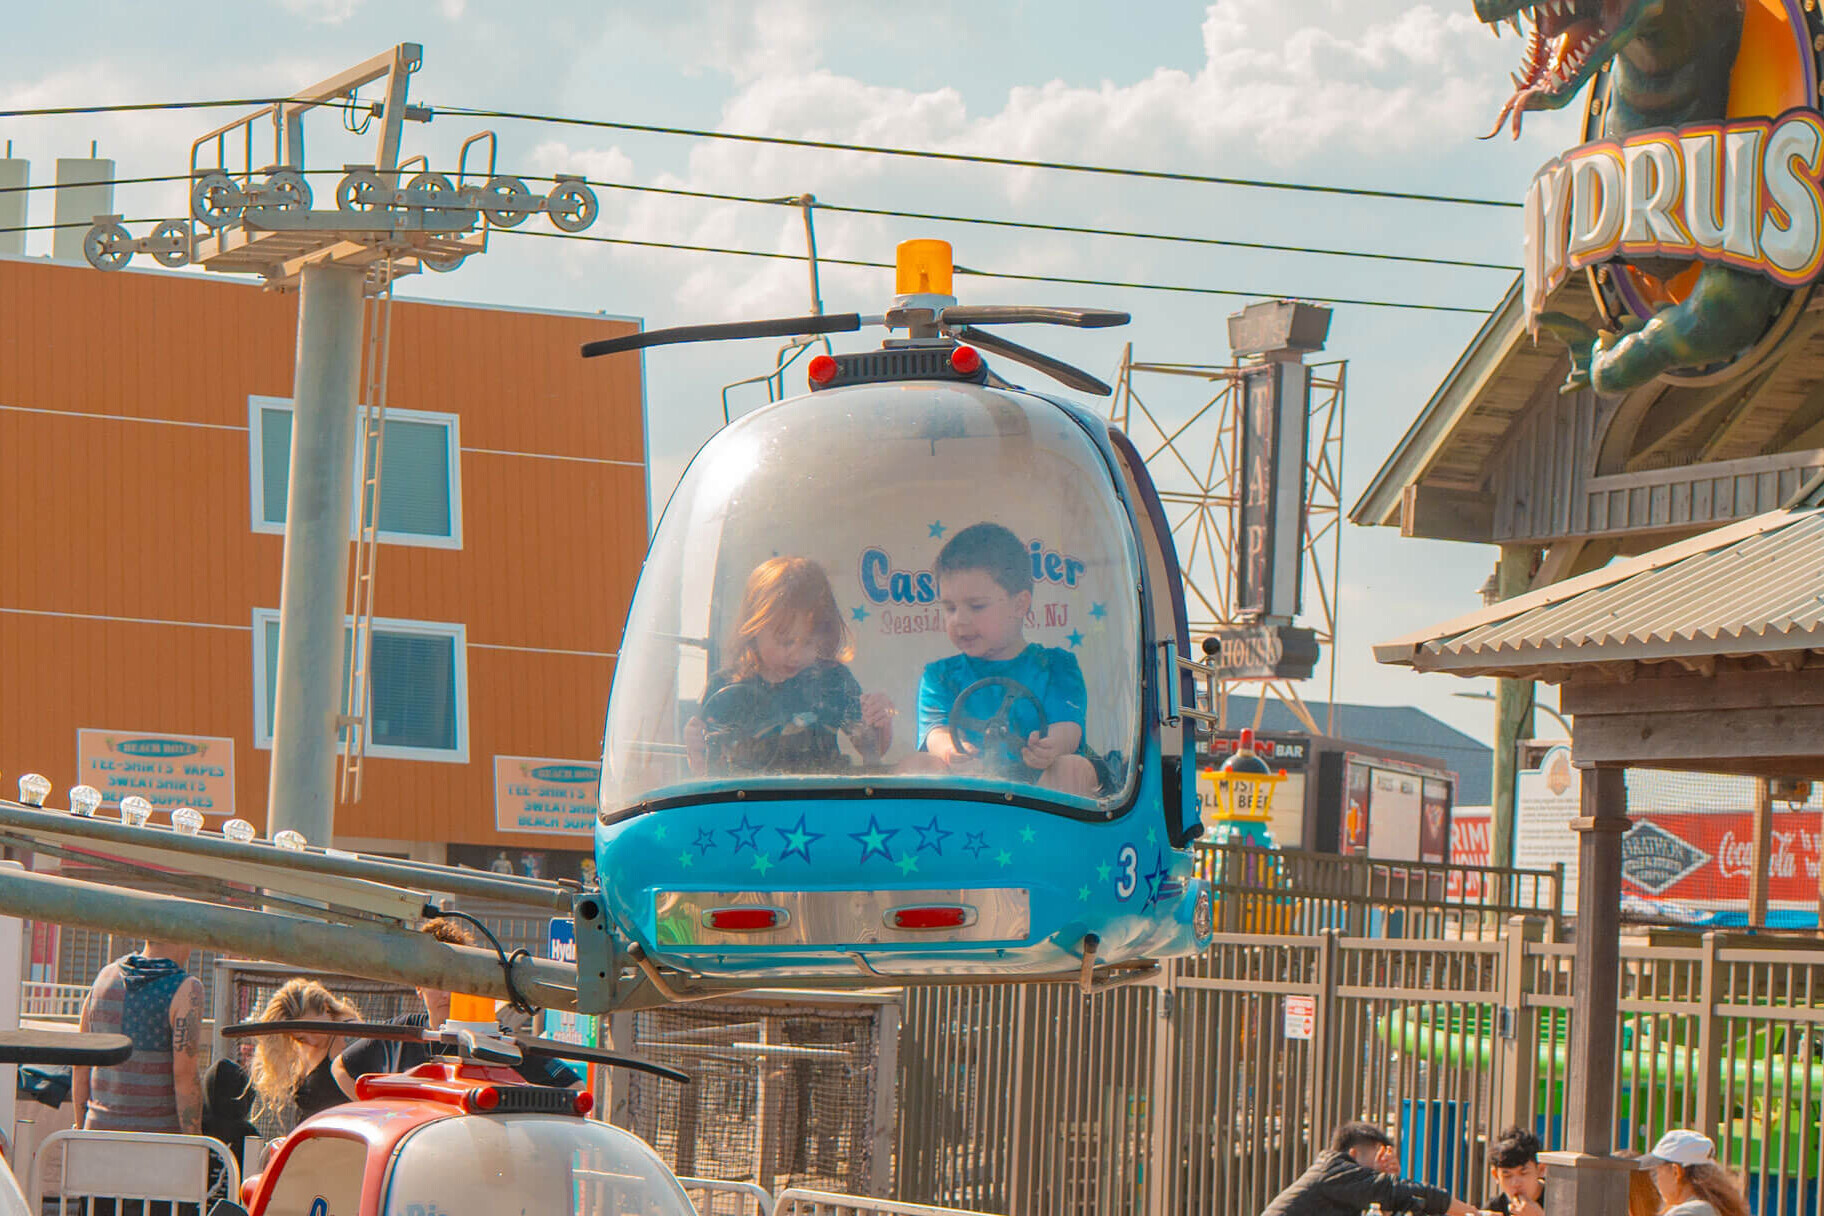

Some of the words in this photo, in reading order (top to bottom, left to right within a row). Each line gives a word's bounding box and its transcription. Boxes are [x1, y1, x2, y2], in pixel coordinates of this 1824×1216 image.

[1524, 113, 1820, 322] YDRUS
[1246, 387, 1268, 592] TAP
[860, 547, 940, 605] Cas
[1029, 541, 1085, 588] ier
[1045, 604, 1069, 627] NJ
[1276, 744, 1304, 758] BAR
[182, 764, 225, 777] VAPES
[108, 775, 207, 792] SWEATSHIRTS
[1219, 780, 1263, 793] MUSI
[150, 793, 214, 808] SUPPLIES
[518, 816, 559, 828] BEACH
[563, 818, 597, 830] SUPP
[1116, 846, 1138, 900] 3
[551, 937, 576, 962] Hydr
